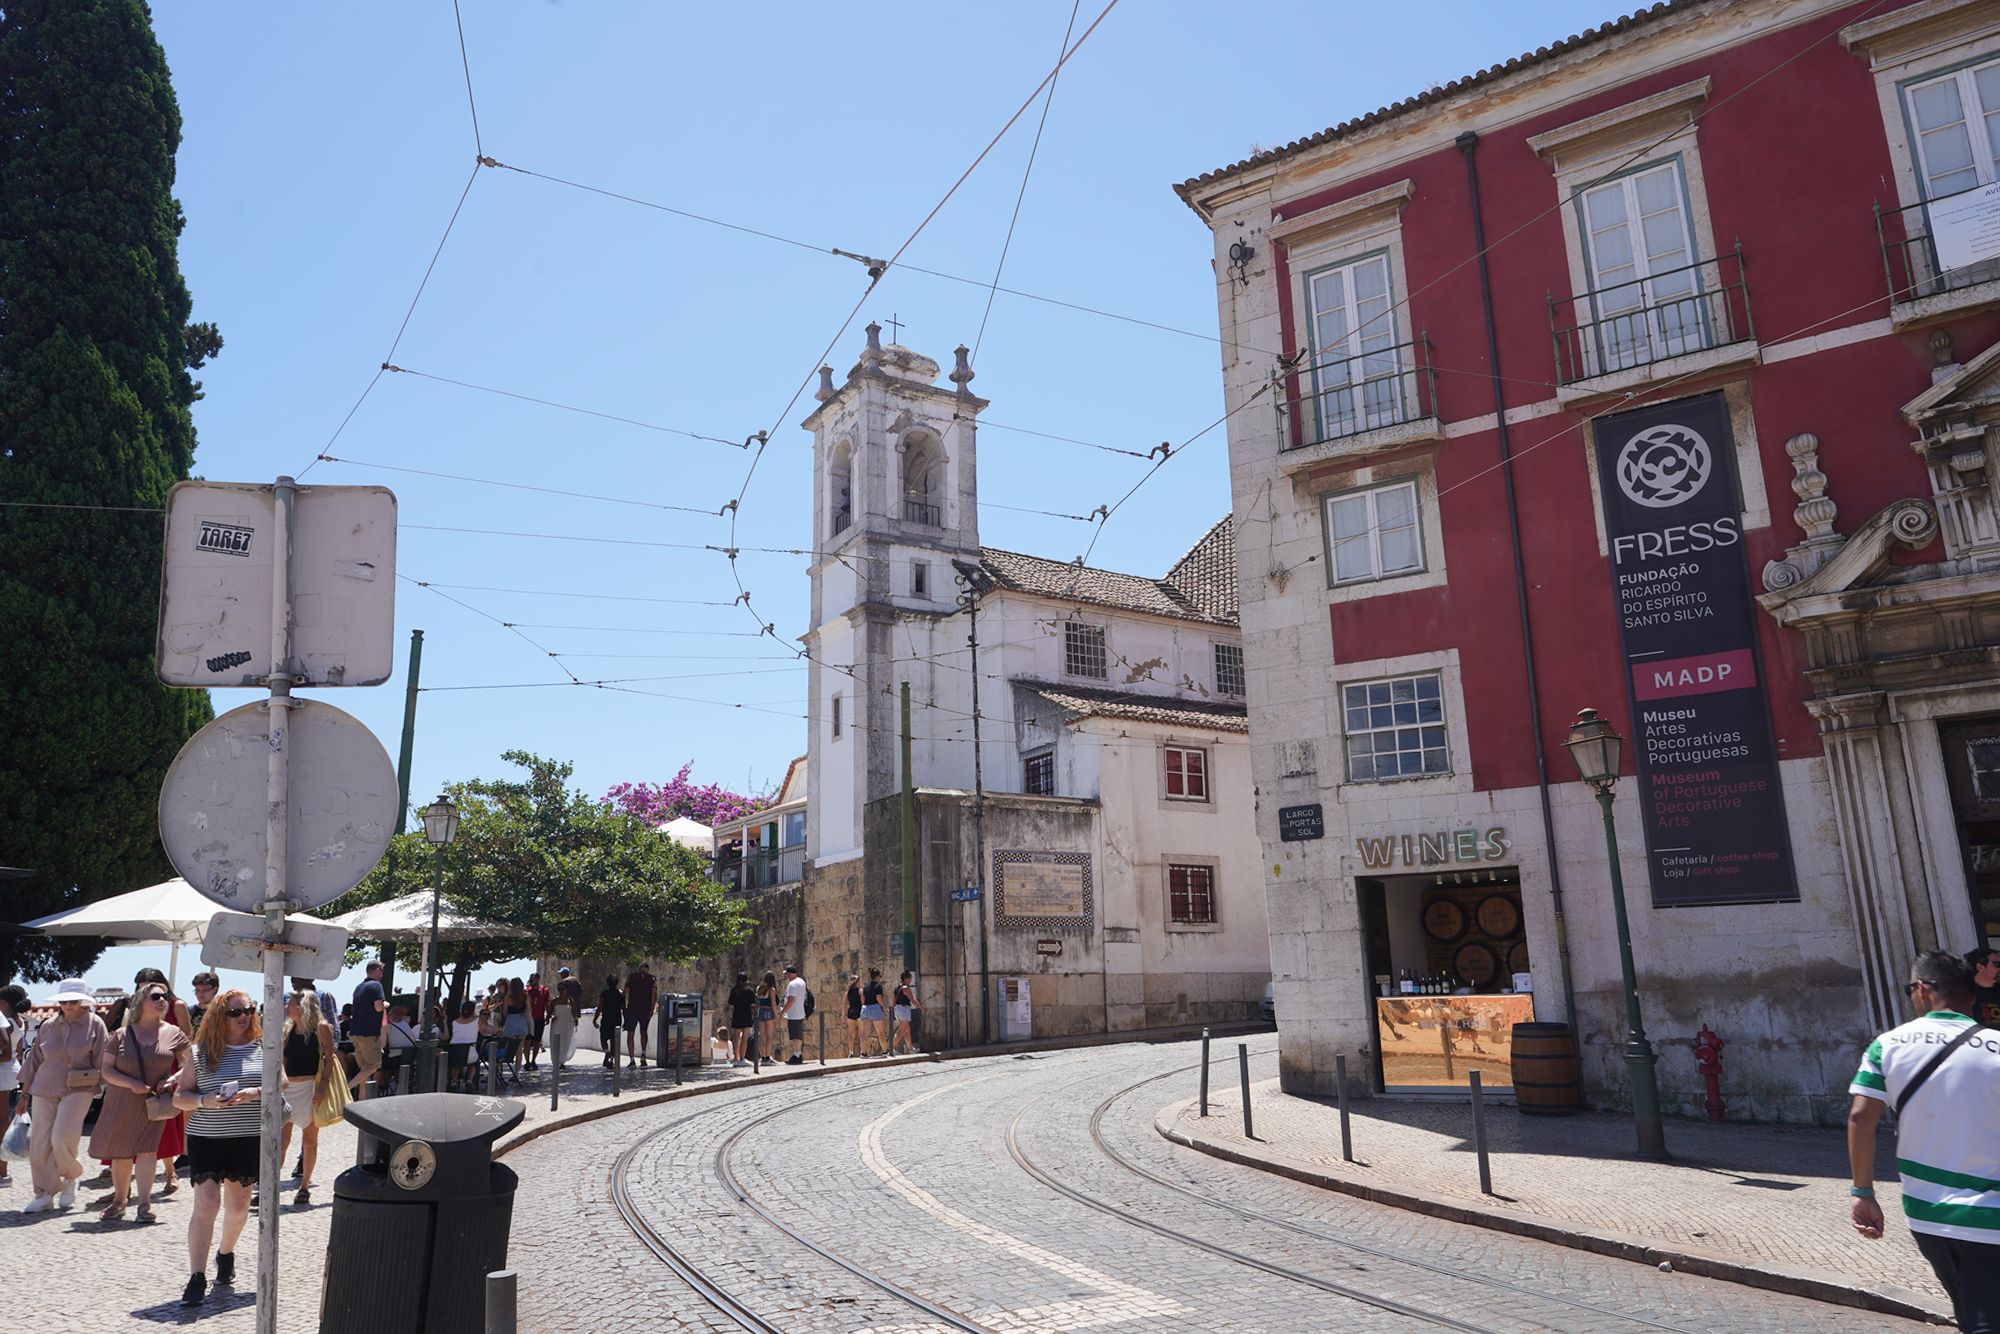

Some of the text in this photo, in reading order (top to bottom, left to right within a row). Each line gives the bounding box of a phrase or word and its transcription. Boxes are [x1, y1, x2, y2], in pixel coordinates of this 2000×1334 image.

[1613, 517, 1739, 565] FRESS
[1619, 563, 1700, 586] FUNDAÇÃO
[1621, 581, 1681, 600] RICARDO
[1623, 591, 1708, 614] DO ESPÍRITO
[1625, 606, 1714, 629] SANTO SILVA
[1653, 663, 1733, 689] MADP
[1643, 707, 1697, 724] Museu
[1645, 722, 1687, 737] Artes
[1647, 729, 1741, 751] Decorativas
[1649, 744, 1749, 765] Portuguesas
[1652, 769, 1721, 786] Museum
[1654, 779, 1767, 800] of Portuguese
[1286, 809, 1314, 818] LARGO
[1656, 796, 1742, 815] Decorative
[1289, 817, 1322, 828] PORTAS
[1657, 815, 1690, 829] Arts
[1297, 828, 1315, 836] SOL
[1357, 826, 1507, 869] WINES
[1661, 854, 1708, 867] Cafetaria
[1752, 850, 1779, 862] shop
[1663, 867, 1684, 879] Loja
[1714, 865, 1740, 876] shop
[1890, 1032, 1949, 1046] SUPER
